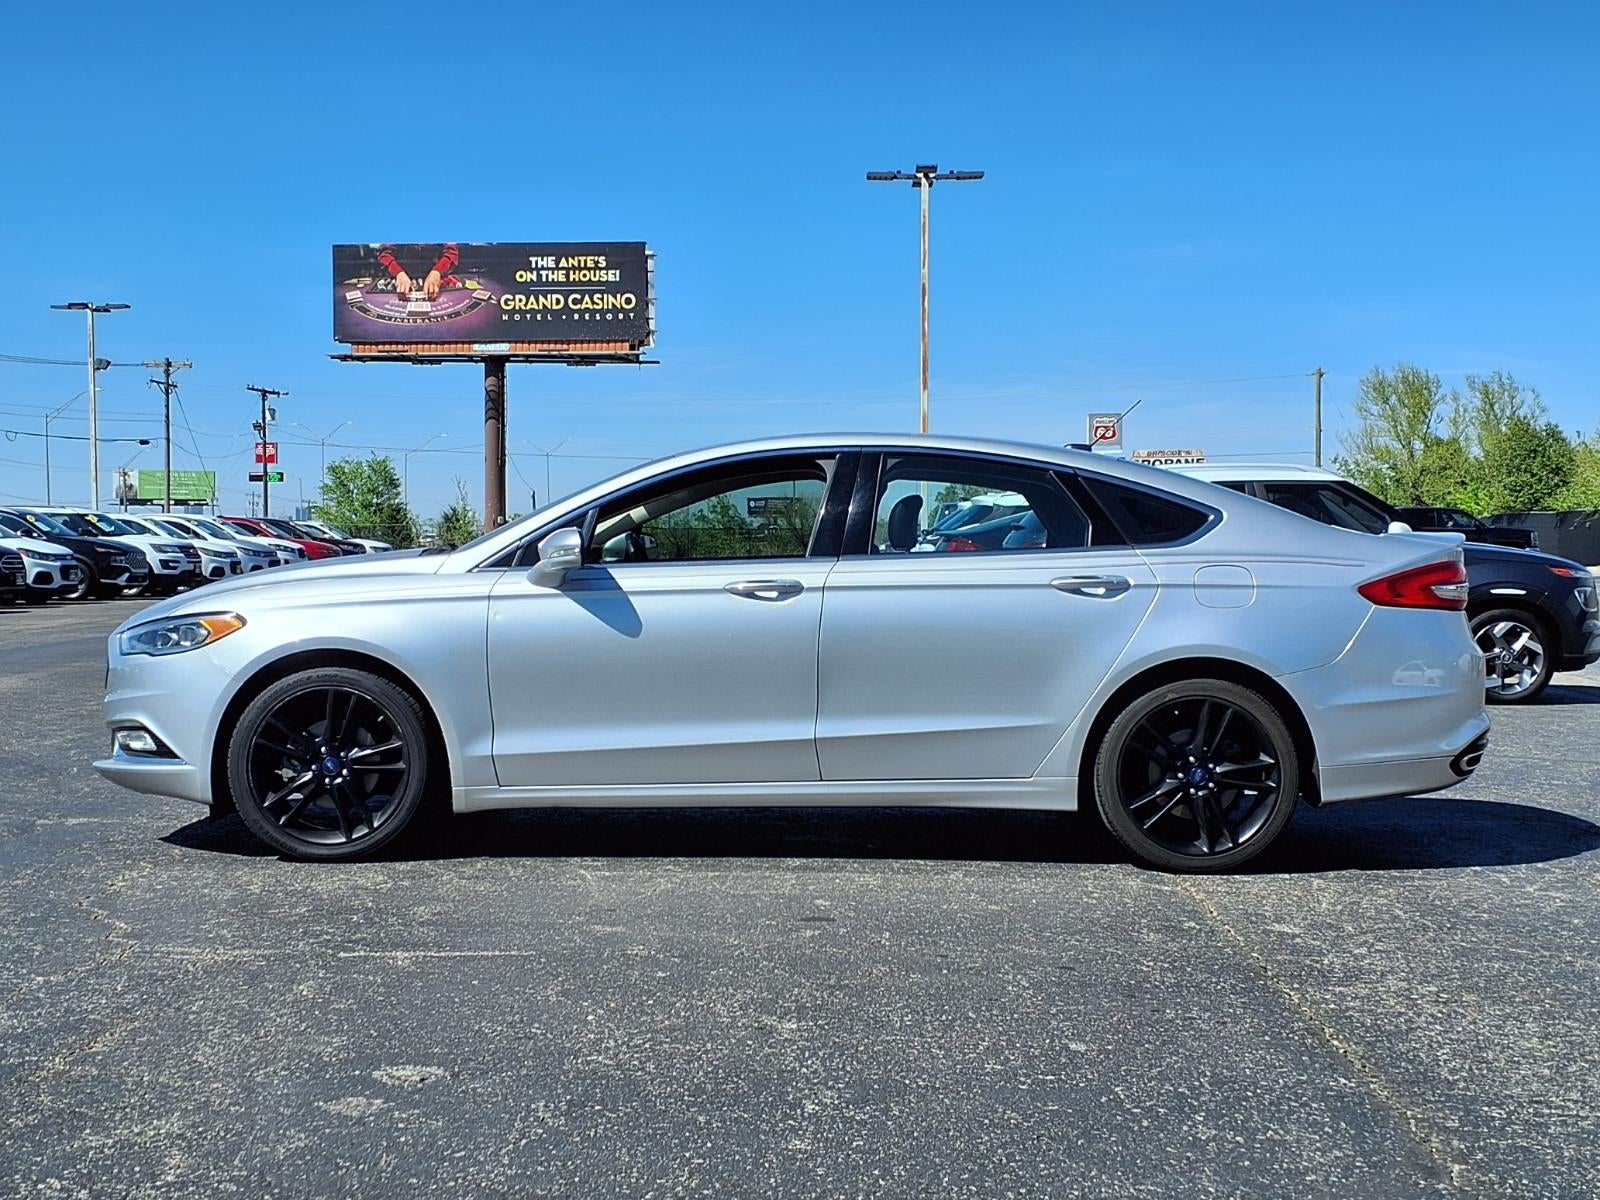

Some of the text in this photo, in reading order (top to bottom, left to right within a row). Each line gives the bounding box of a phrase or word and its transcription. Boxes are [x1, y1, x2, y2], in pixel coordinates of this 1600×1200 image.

[529, 255, 607, 268] THE ANTE'S
[515, 269, 620, 282] ON THE HOUSE!
[500, 293, 637, 310] GRAND CASINO
